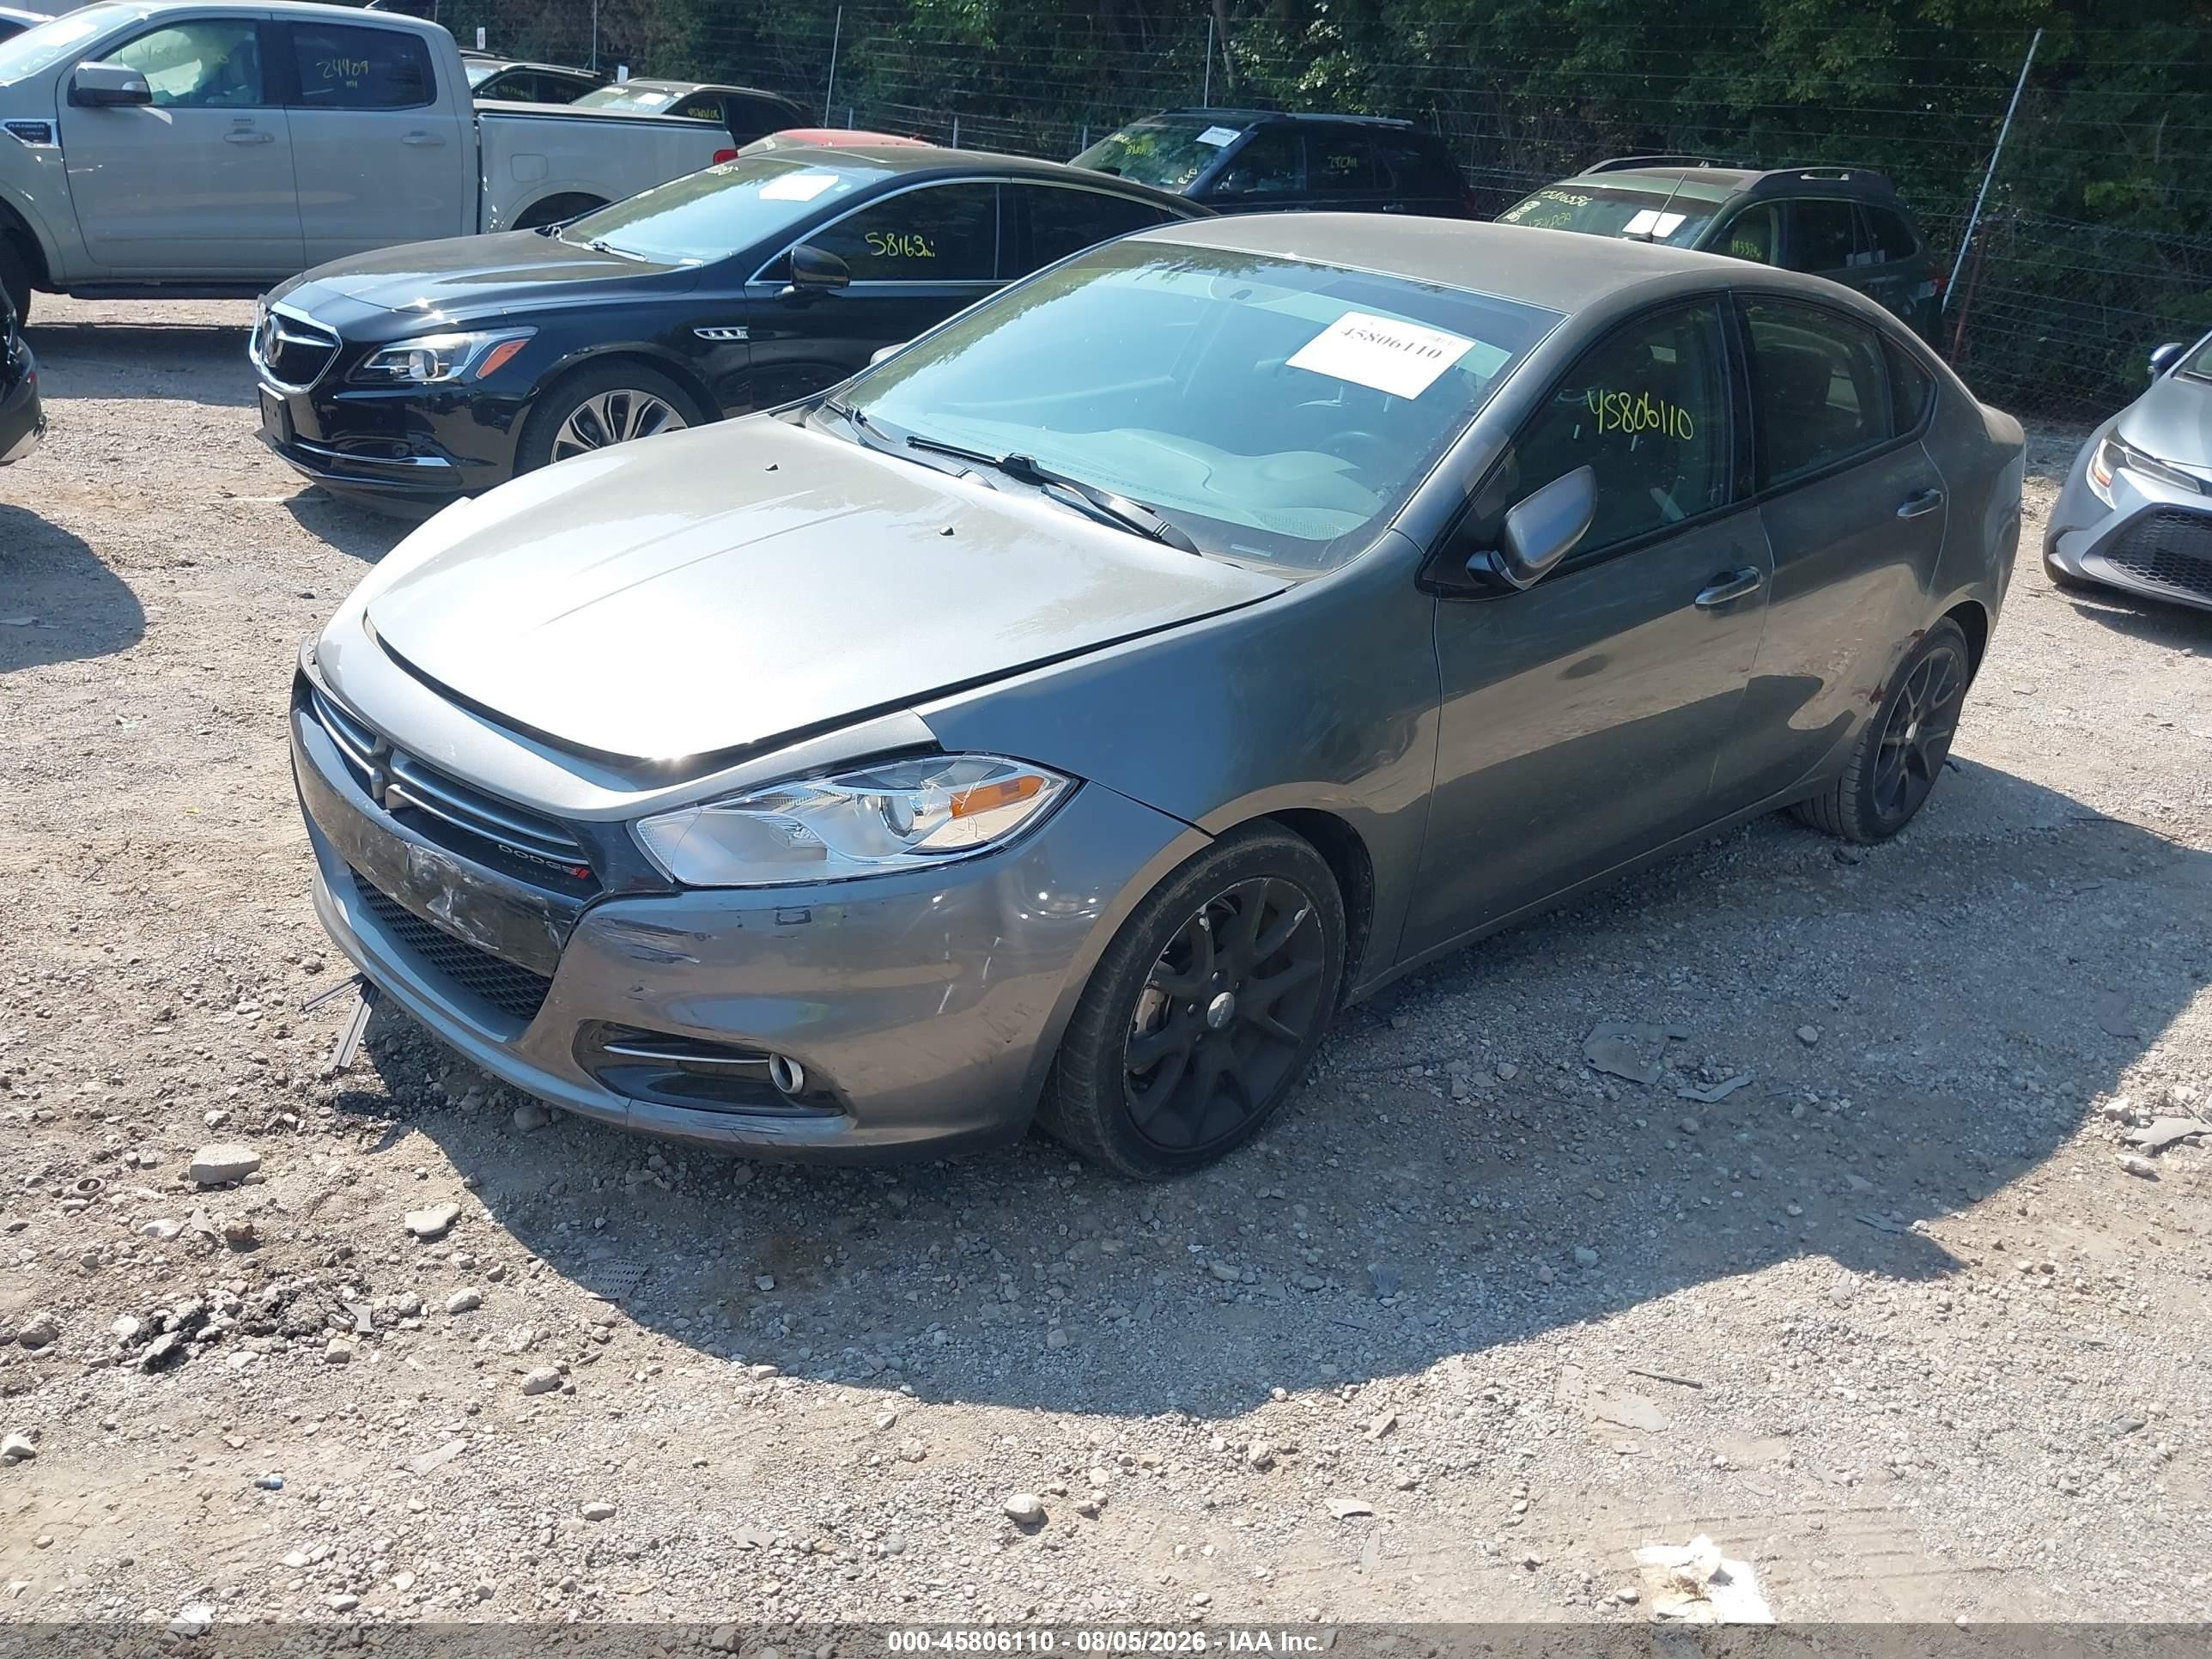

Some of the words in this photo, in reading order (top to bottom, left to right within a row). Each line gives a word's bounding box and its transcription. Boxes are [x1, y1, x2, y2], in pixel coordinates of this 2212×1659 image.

[315, 58, 369, 79] 24409
[1587, 388, 1693, 441] 45806110
[498, 844, 578, 876] DODGE
